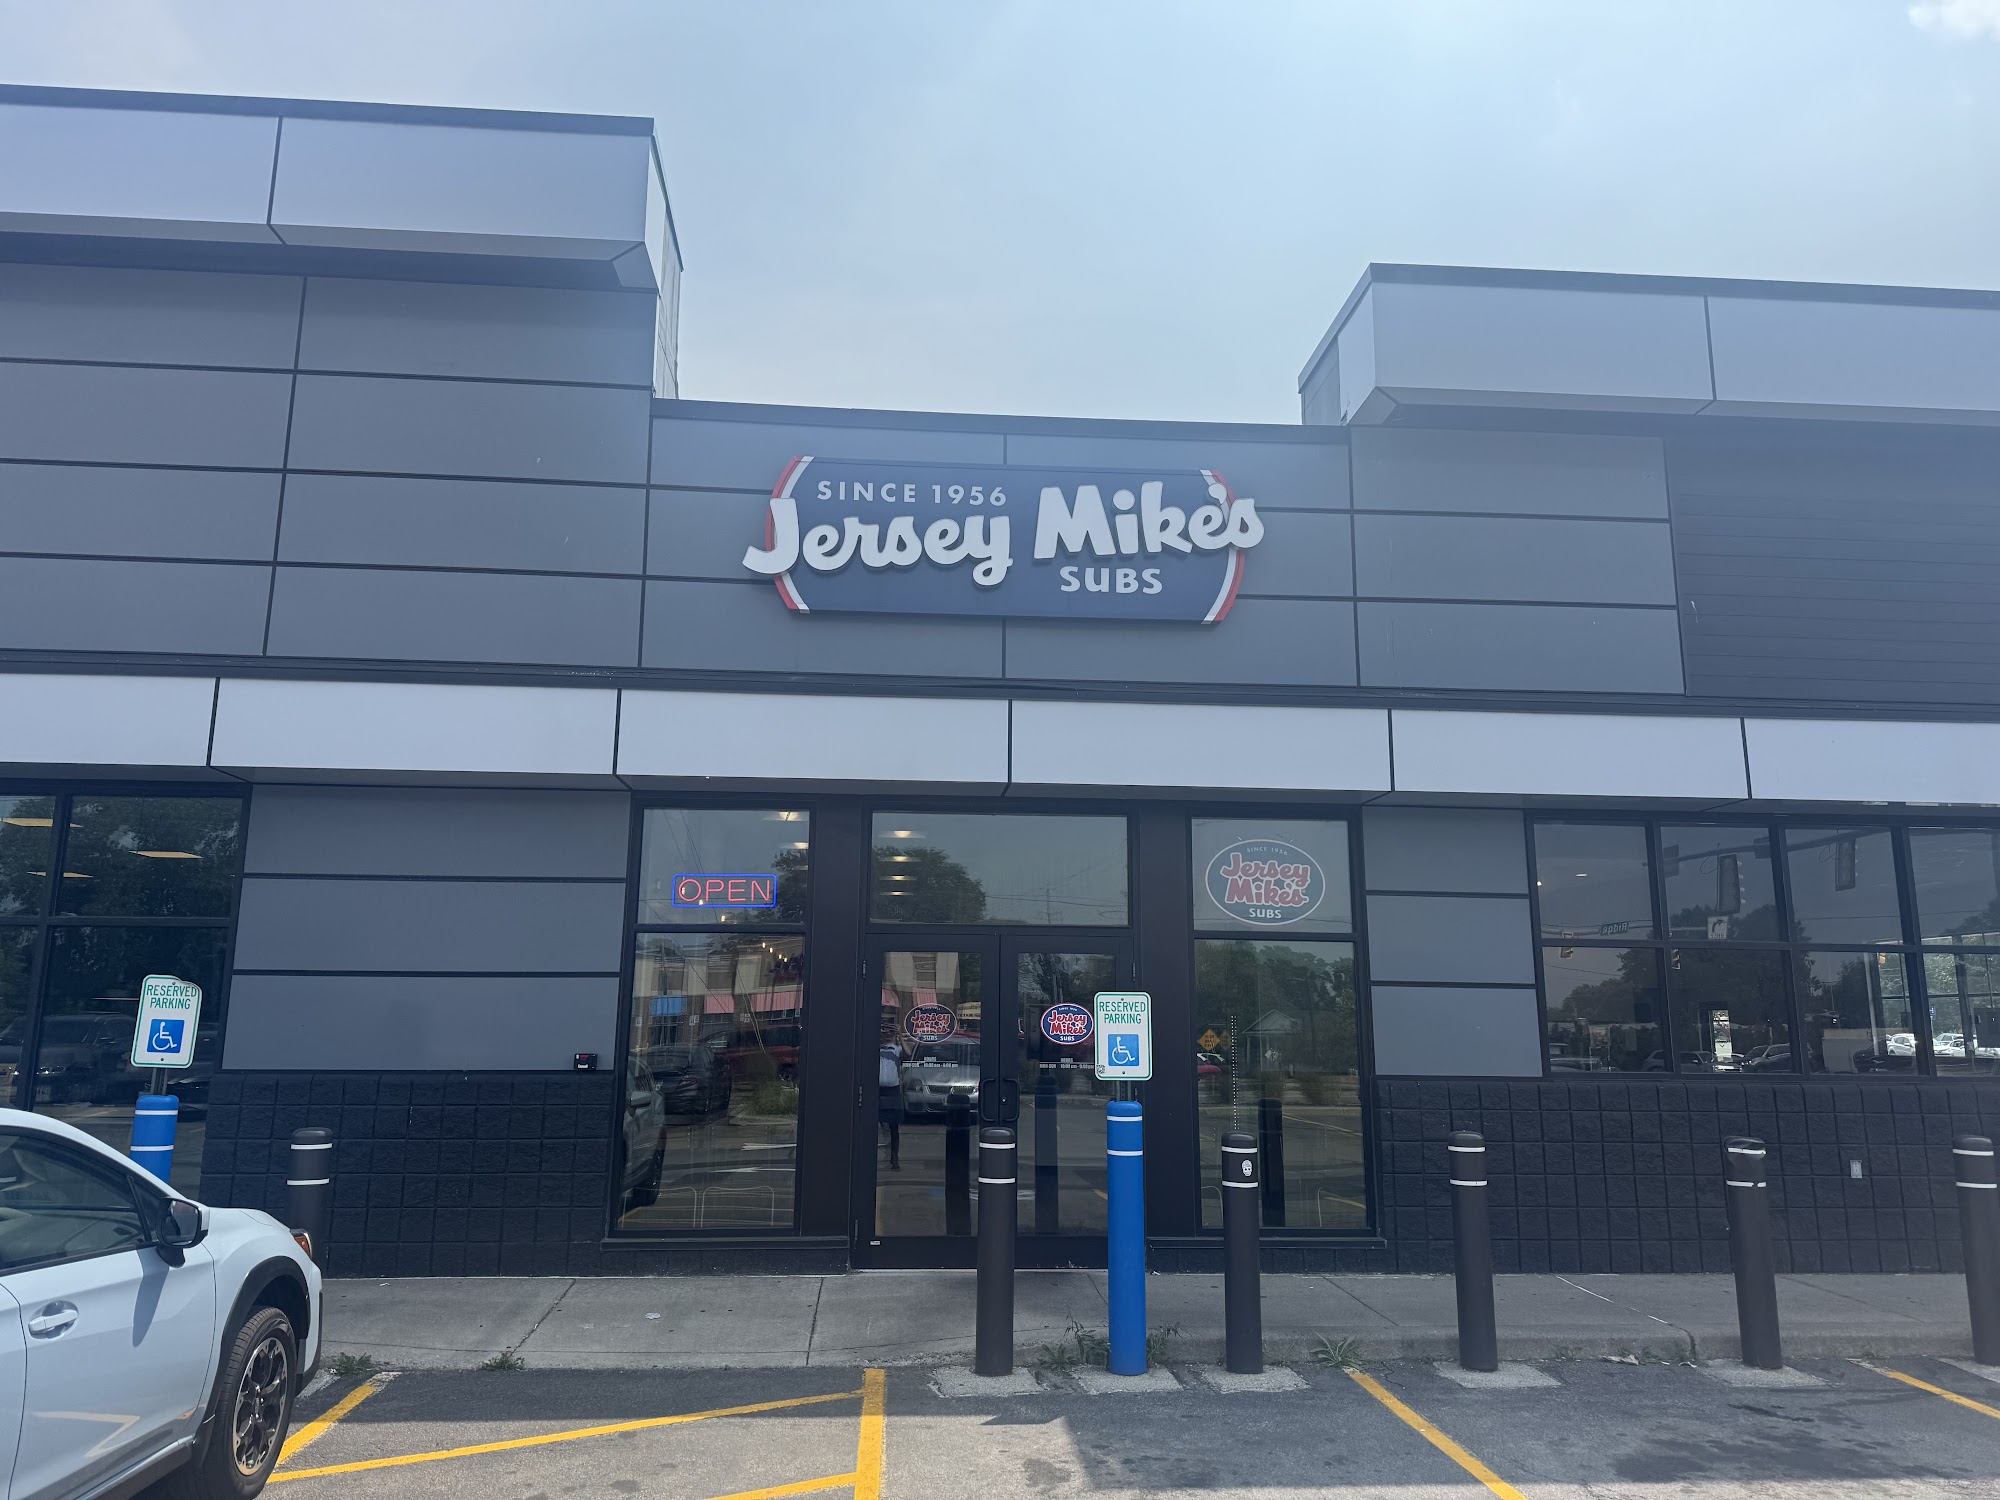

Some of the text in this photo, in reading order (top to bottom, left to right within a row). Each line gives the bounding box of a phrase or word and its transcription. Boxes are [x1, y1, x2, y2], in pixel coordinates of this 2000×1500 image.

[817, 480, 1007, 506] SINCE 1956
[742, 480, 1265, 586] Jersey Mike's
[1059, 566, 1163, 594] SUBS
[1270, 847, 1288, 856] 1956
[1220, 852, 1311, 889] Jersey
[678, 879, 771, 902] OPEN
[1225, 877, 1309, 907] Mike's
[1249, 908, 1282, 919] SUBS
[146, 984, 197, 997] RESERVED
[149, 997, 191, 1009] PARKING
[1099, 1001, 1146, 1012] RESERVED
[911, 1010, 951, 1027] Jersey
[1048, 1010, 1088, 1028] Jersey
[1104, 1013, 1142, 1024] PARKING
[1050, 1022, 1087, 1036] Mike's
